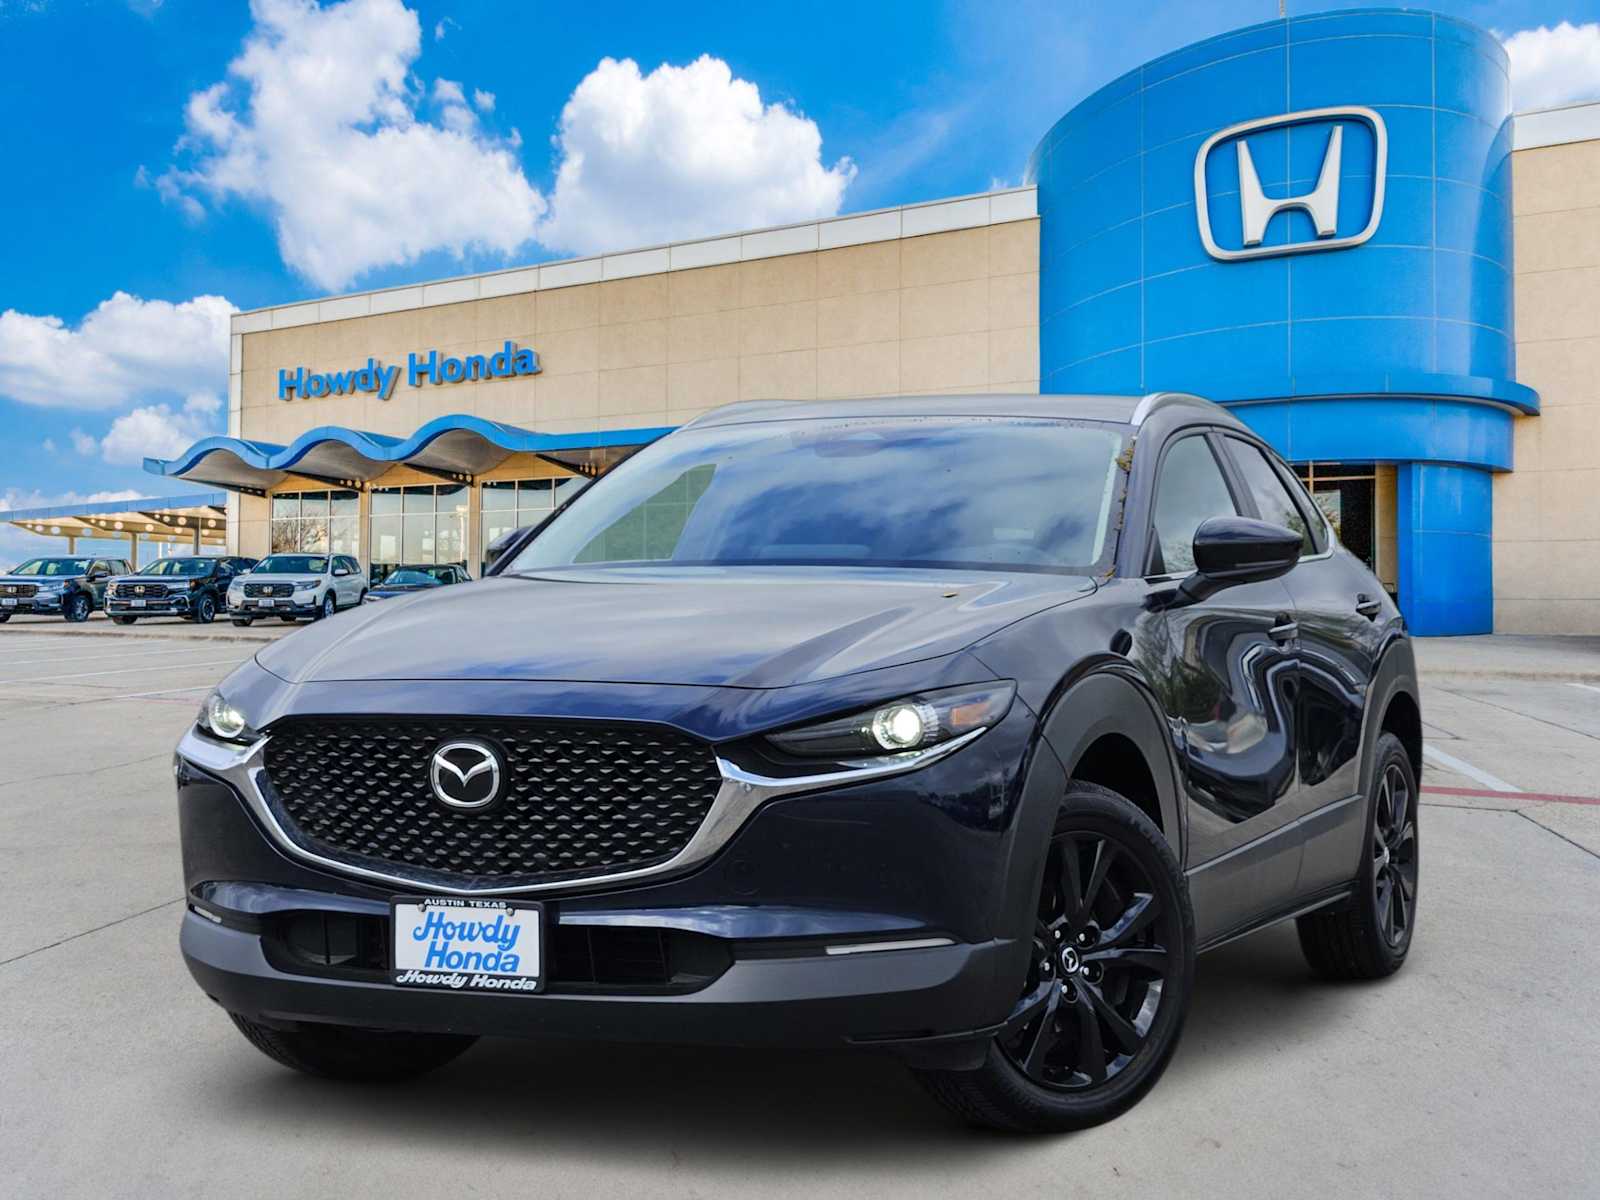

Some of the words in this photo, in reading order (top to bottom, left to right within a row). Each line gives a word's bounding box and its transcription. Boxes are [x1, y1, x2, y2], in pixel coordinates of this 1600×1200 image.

[278, 358, 400, 401] Howdy
[408, 340, 542, 388] Honda
[424, 898, 465, 907] AUSTIN
[469, 900, 507, 909] TEXAS
[413, 911, 521, 951] Howdy
[424, 941, 520, 972] Honda
[396, 969, 468, 989] Howdy
[469, 974, 537, 991] Honda
